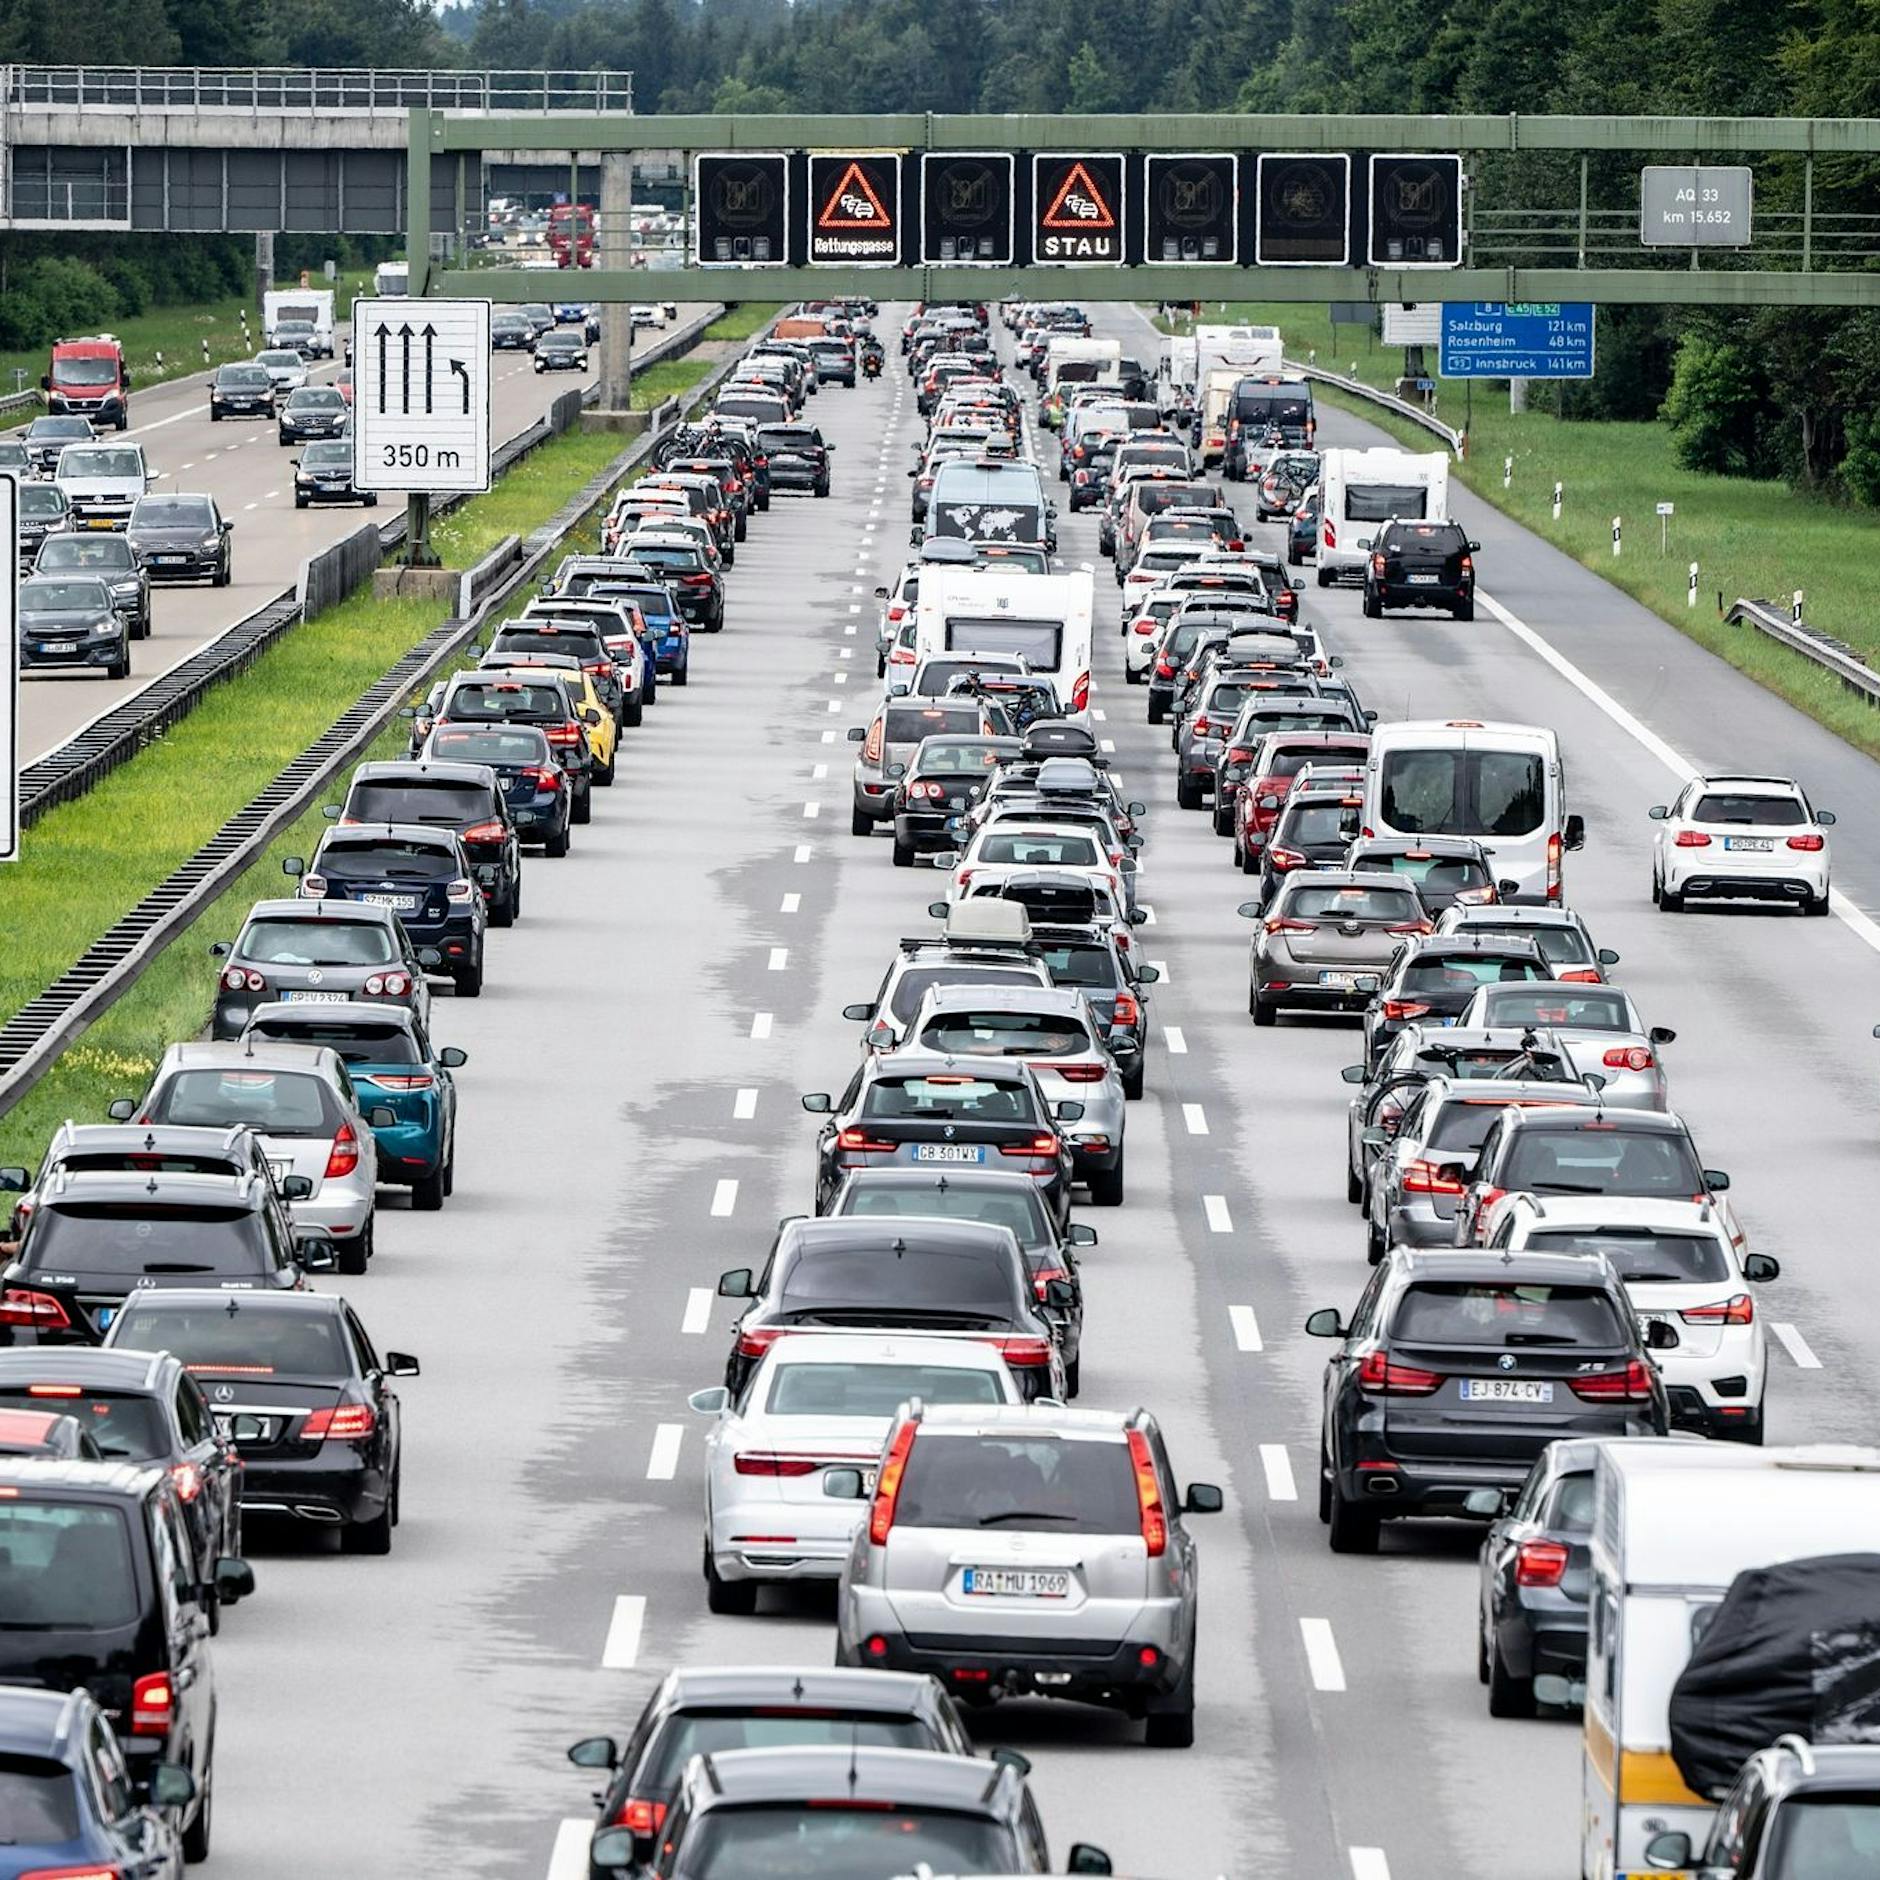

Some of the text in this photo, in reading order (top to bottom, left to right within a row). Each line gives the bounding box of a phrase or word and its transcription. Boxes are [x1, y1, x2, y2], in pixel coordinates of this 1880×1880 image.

[1675, 188, 1719, 202] AQ 33
[1663, 210, 1731, 223] km 15.652
[814, 237, 894, 255] Rettungsgasse
[1045, 236, 1110, 255] STAU
[1448, 320, 1586, 333] Salzburg 121 km
[1448, 336, 1586, 347] Rosenheim 48 km
[1475, 358, 1537, 369] Innsbruck
[1548, 358, 1565, 369] 141
[1566, 358, 1586, 369] km
[383, 445, 459, 468] 350 m
[974, 1572, 1066, 1591] RA MU 1969
